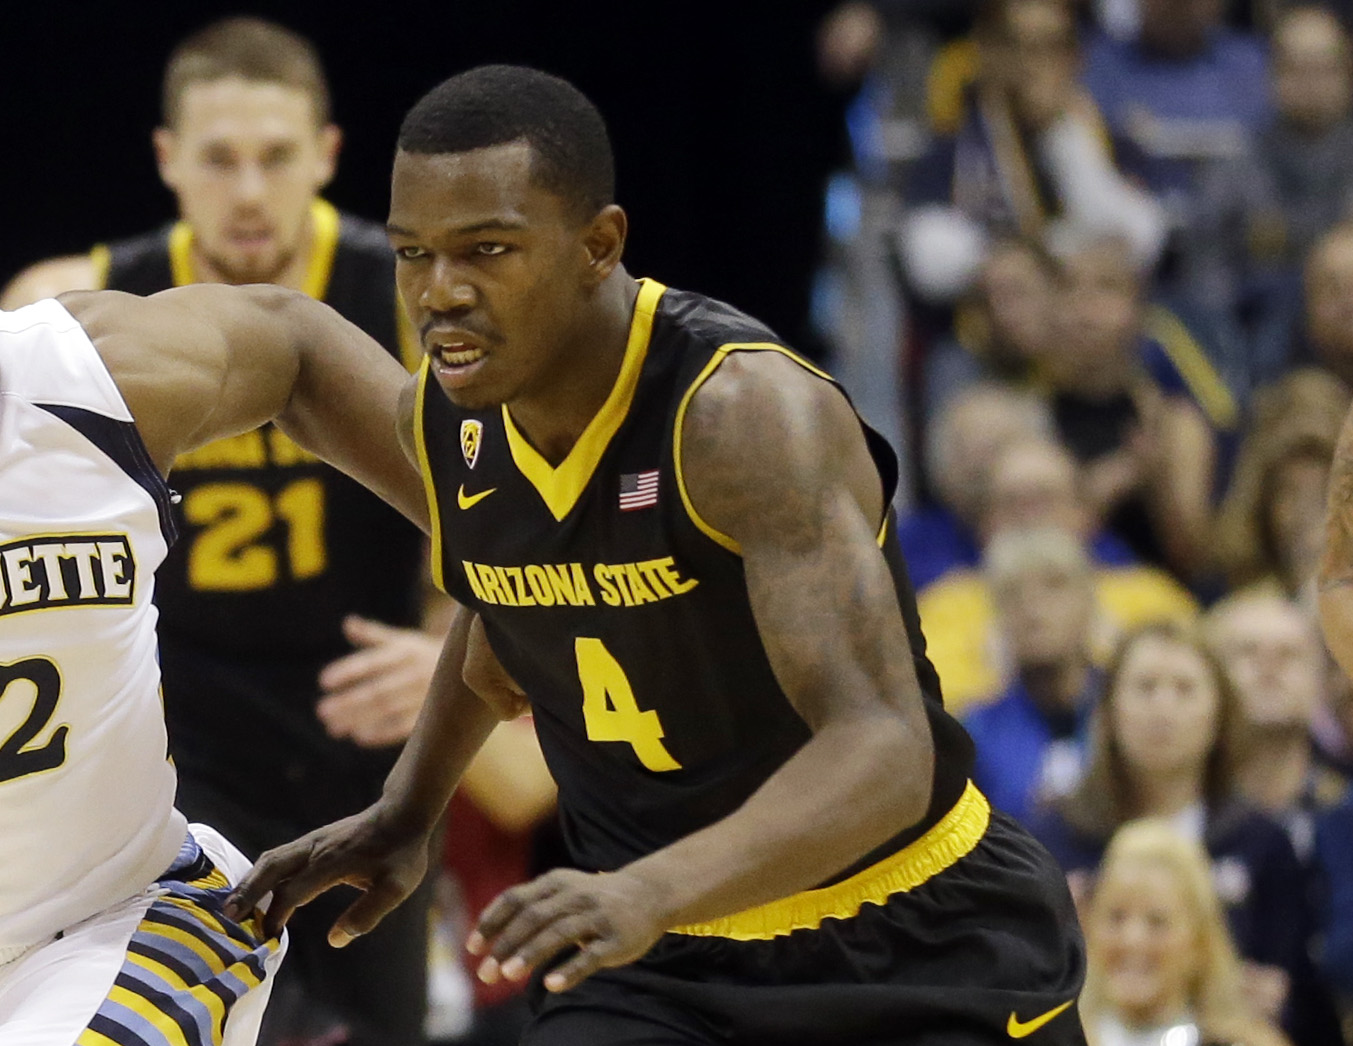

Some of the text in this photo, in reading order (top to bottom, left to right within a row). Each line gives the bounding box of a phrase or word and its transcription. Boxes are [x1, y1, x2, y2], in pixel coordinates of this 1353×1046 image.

[185, 478, 328, 590] 21
[463, 556, 700, 607] ARIZONA STATE
[574, 637, 682, 773] 4
